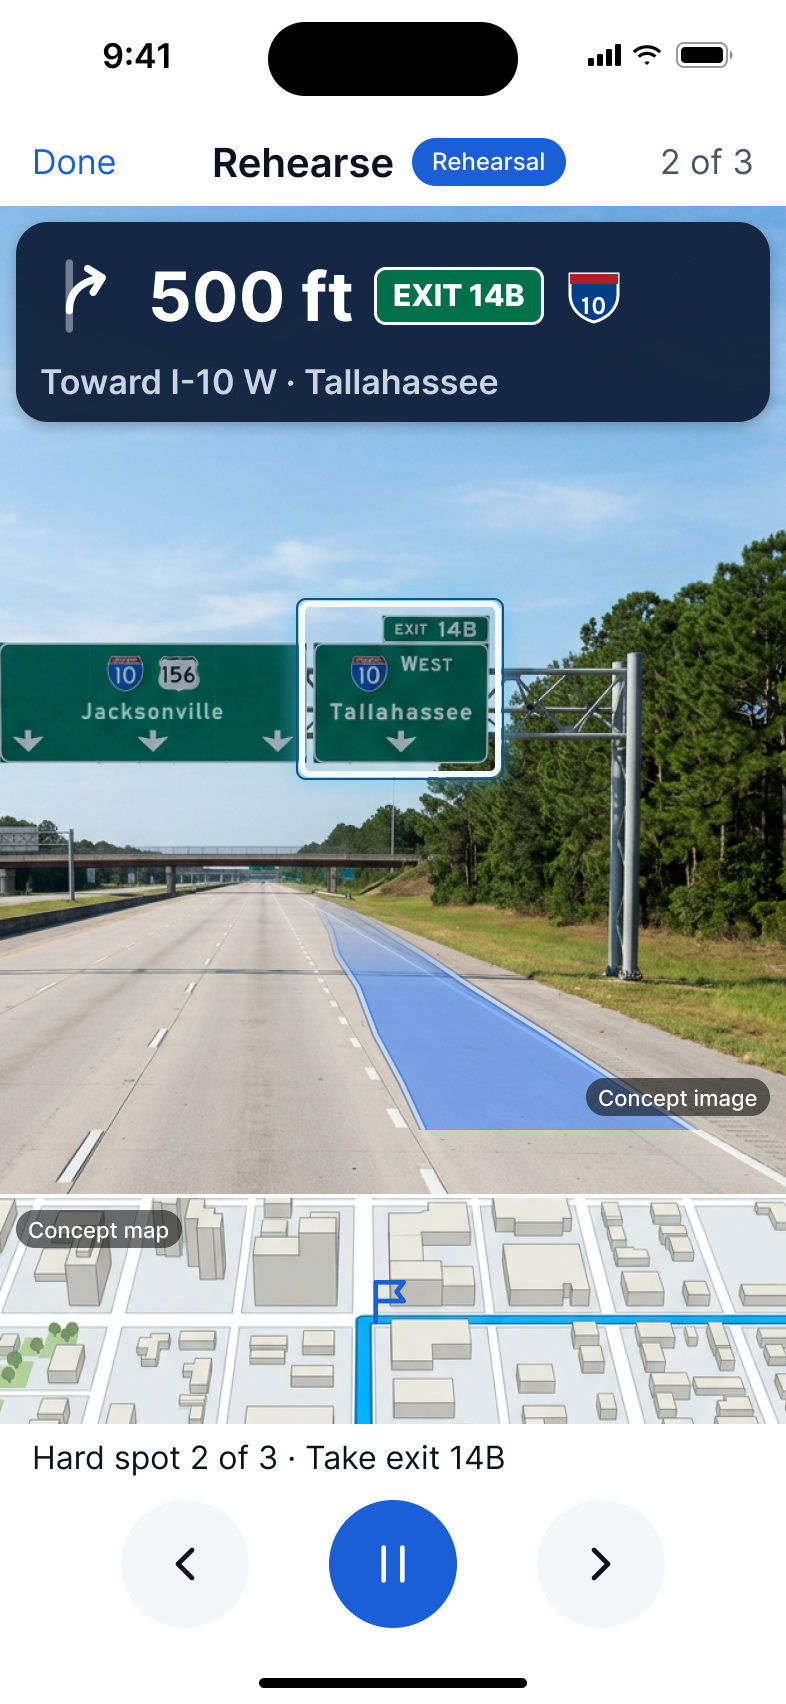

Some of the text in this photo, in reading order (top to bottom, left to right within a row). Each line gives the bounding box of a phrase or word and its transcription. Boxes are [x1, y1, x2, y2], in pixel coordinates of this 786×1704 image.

[103, 42, 171, 70] 9:41
[34, 148, 116, 176] Done
[213, 147, 394, 179] Rehearse
[432, 151, 546, 172] Rehearsal
[661, 147, 753, 176] 2 of 3
[151, 268, 353, 324] 500 ft
[393, 283, 525, 308] EXIT 14B
[581, 296, 606, 315] 10
[40, 368, 161, 396] Toward
[172, 368, 234, 396] I-10
[243, 368, 278, 395] W
[304, 368, 498, 396] Tallahassee
[394, 621, 478, 638] EXIT 14B
[400, 655, 453, 672] WEST
[115, 665, 137, 685] 10
[162, 665, 197, 684] 156
[359, 665, 381, 685] 10
[81, 702, 224, 721] Jacksonville
[329, 702, 473, 721] Tallahassee
[33, 1445, 103, 1471] Hard
[115, 1446, 181, 1477] spot
[191, 1444, 208, 1470] 2
[219, 1443, 249, 1471] of
[259, 1444, 277, 1471] 3
[305, 1445, 376, 1471] Take
[386, 1444, 440, 1471] exit
[450, 1445, 505, 1470] 14B
